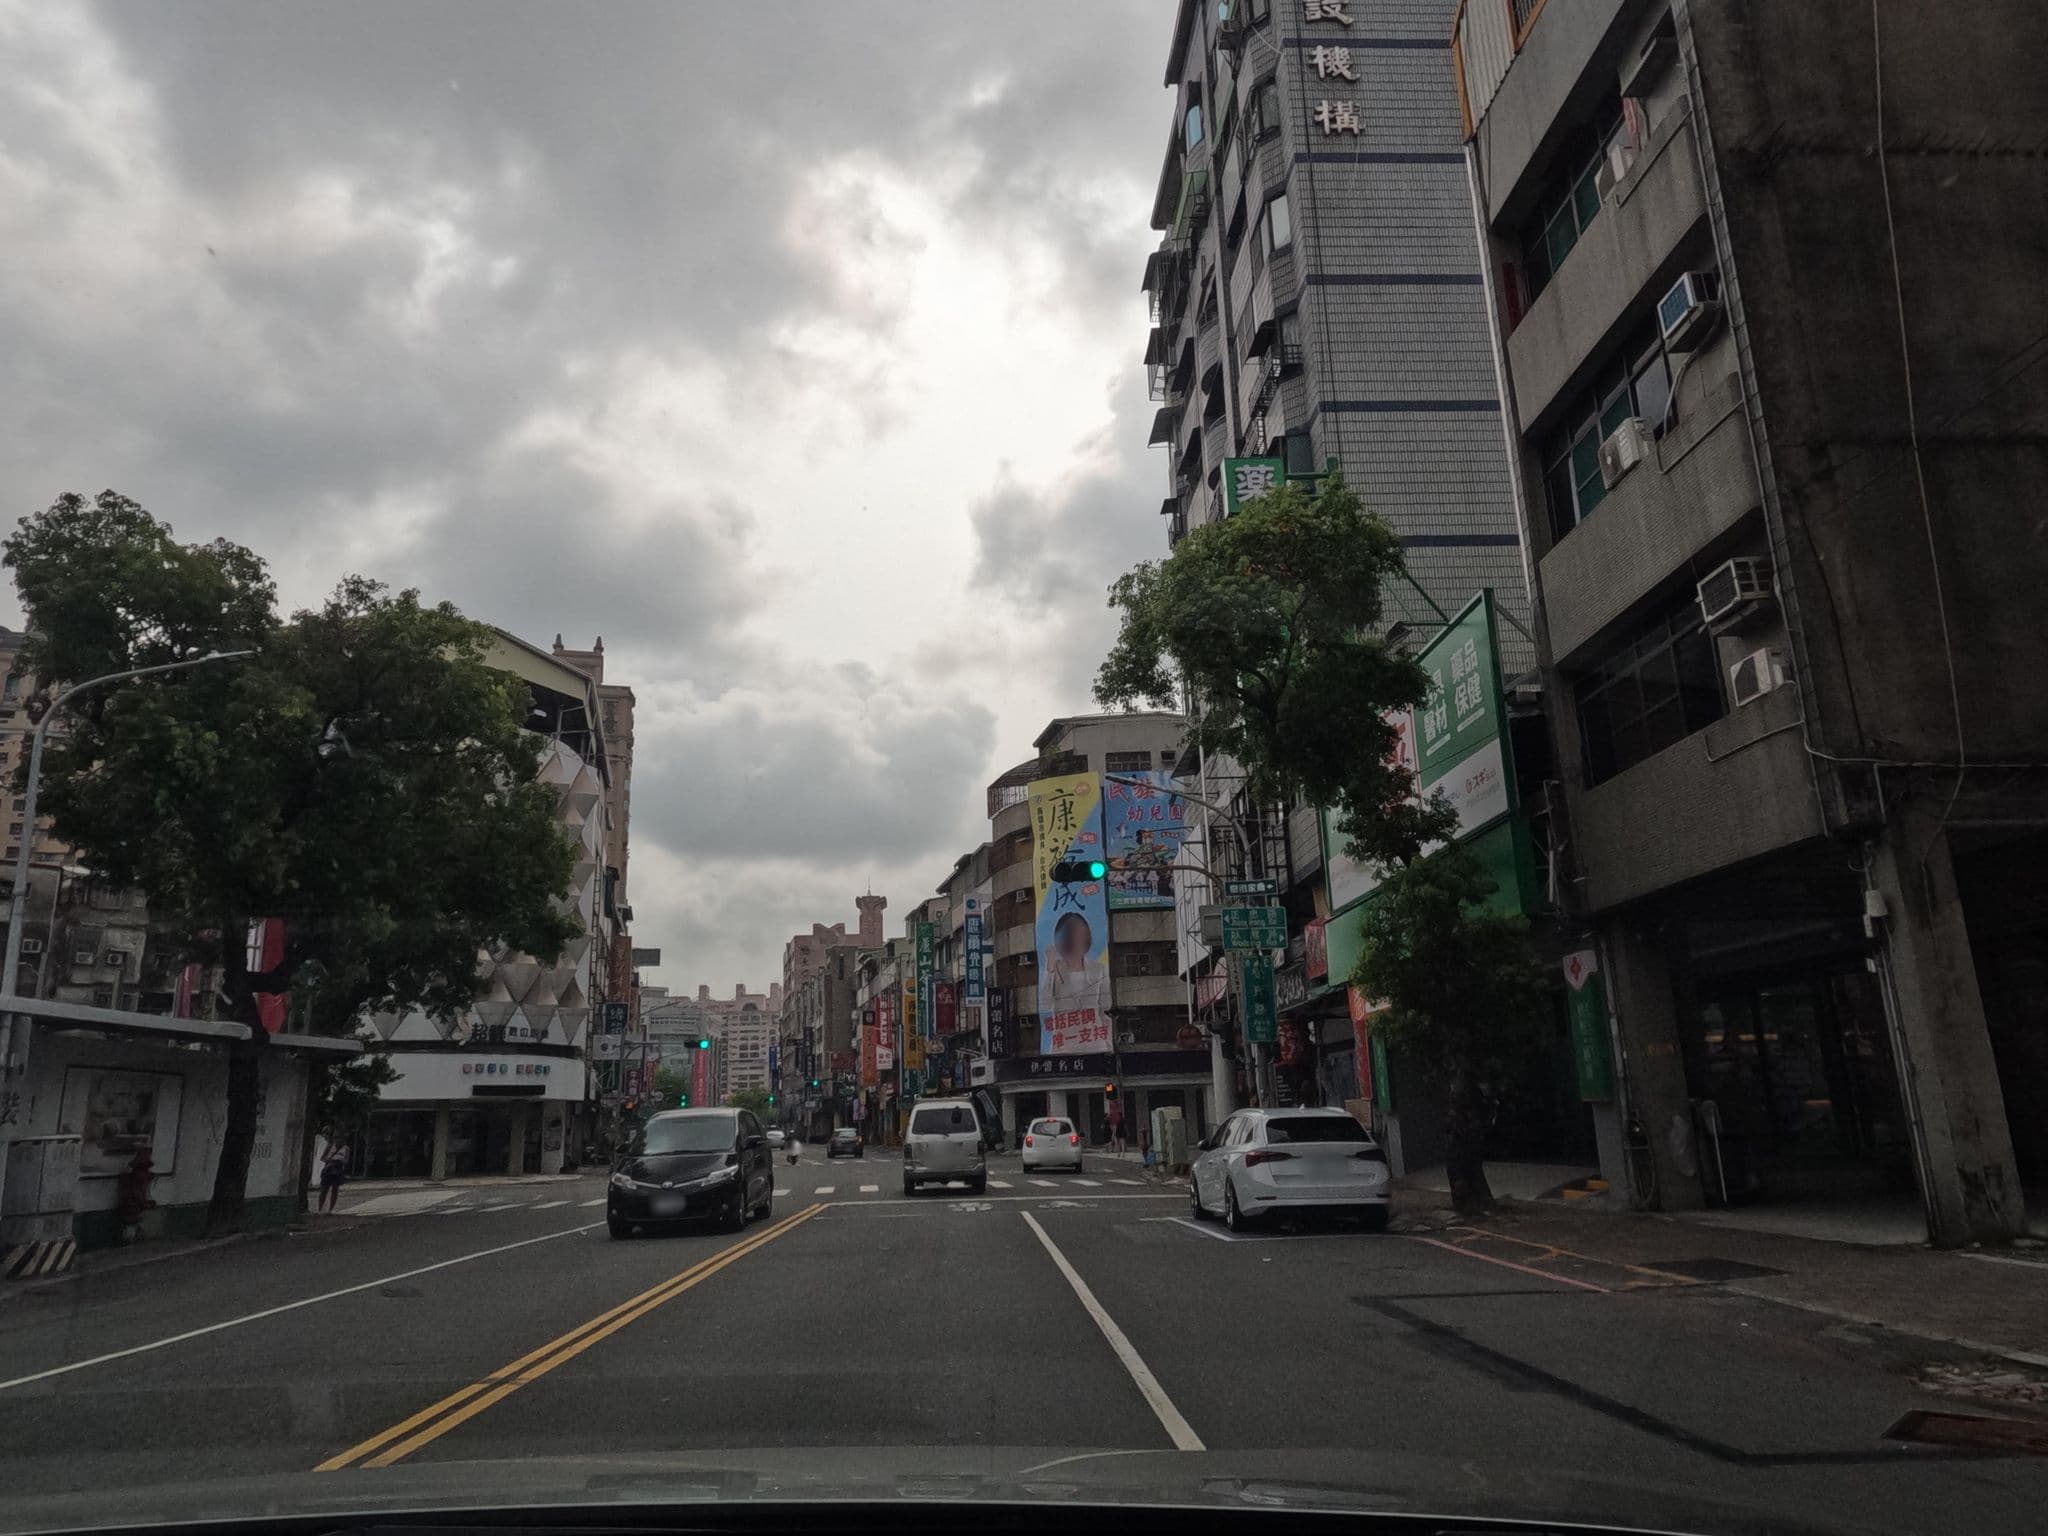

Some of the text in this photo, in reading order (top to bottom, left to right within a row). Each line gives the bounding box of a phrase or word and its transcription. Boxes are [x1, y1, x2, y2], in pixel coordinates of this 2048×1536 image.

[1454, 672, 1483, 719] 保健
[1044, 1008, 1096, 1032] 電話民調
[1052, 1025, 1109, 1048] 唯一支持
